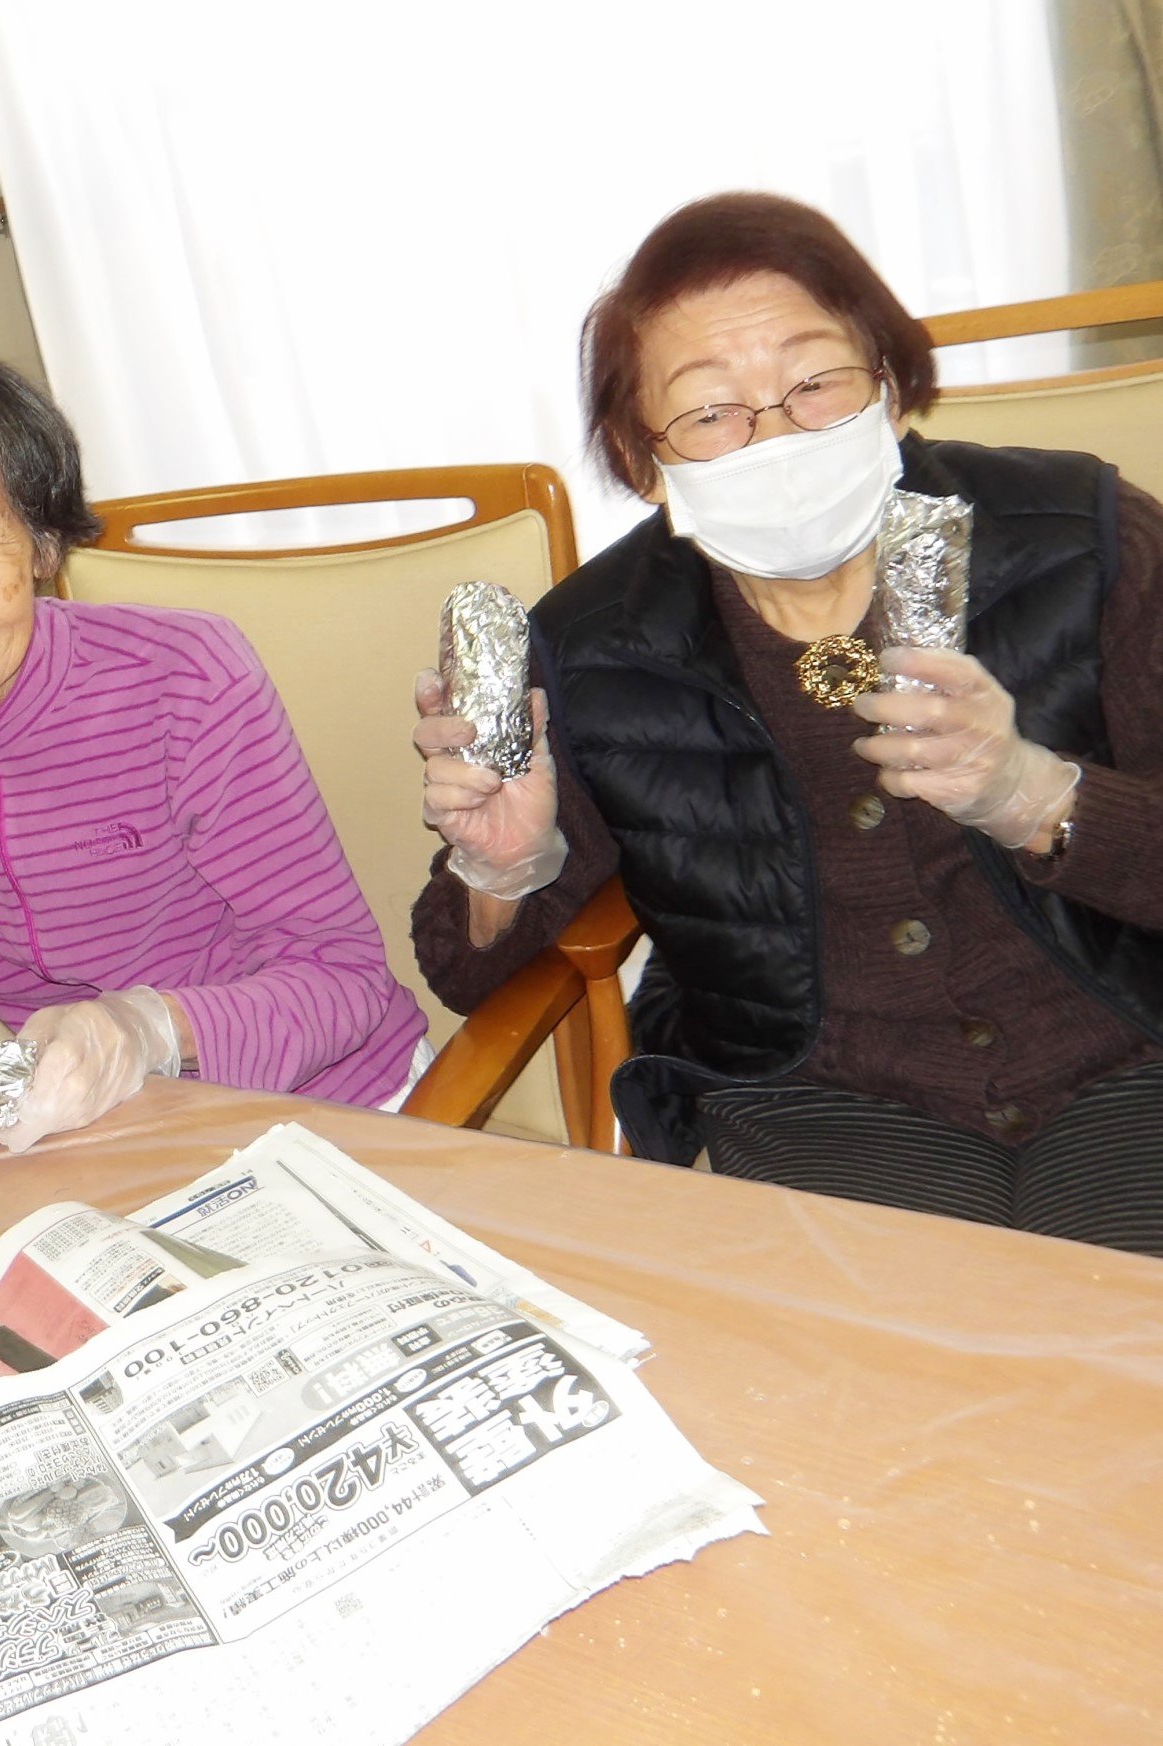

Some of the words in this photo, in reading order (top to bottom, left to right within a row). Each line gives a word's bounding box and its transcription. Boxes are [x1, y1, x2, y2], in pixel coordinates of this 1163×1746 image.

[121, 1260, 361, 1379] 0120-860-100
[231, 1279, 343, 1338] ハートペイント
[312, 1342, 399, 1405] 無料!
[412, 1336, 566, 1445] 塗装
[443, 1373, 594, 1488] 外壁
[69, 1460, 107, 1483] なんと!
[182, 1466, 258, 1520] 1万円分プレゼント!
[388, 1450, 426, 1477] まるごと
